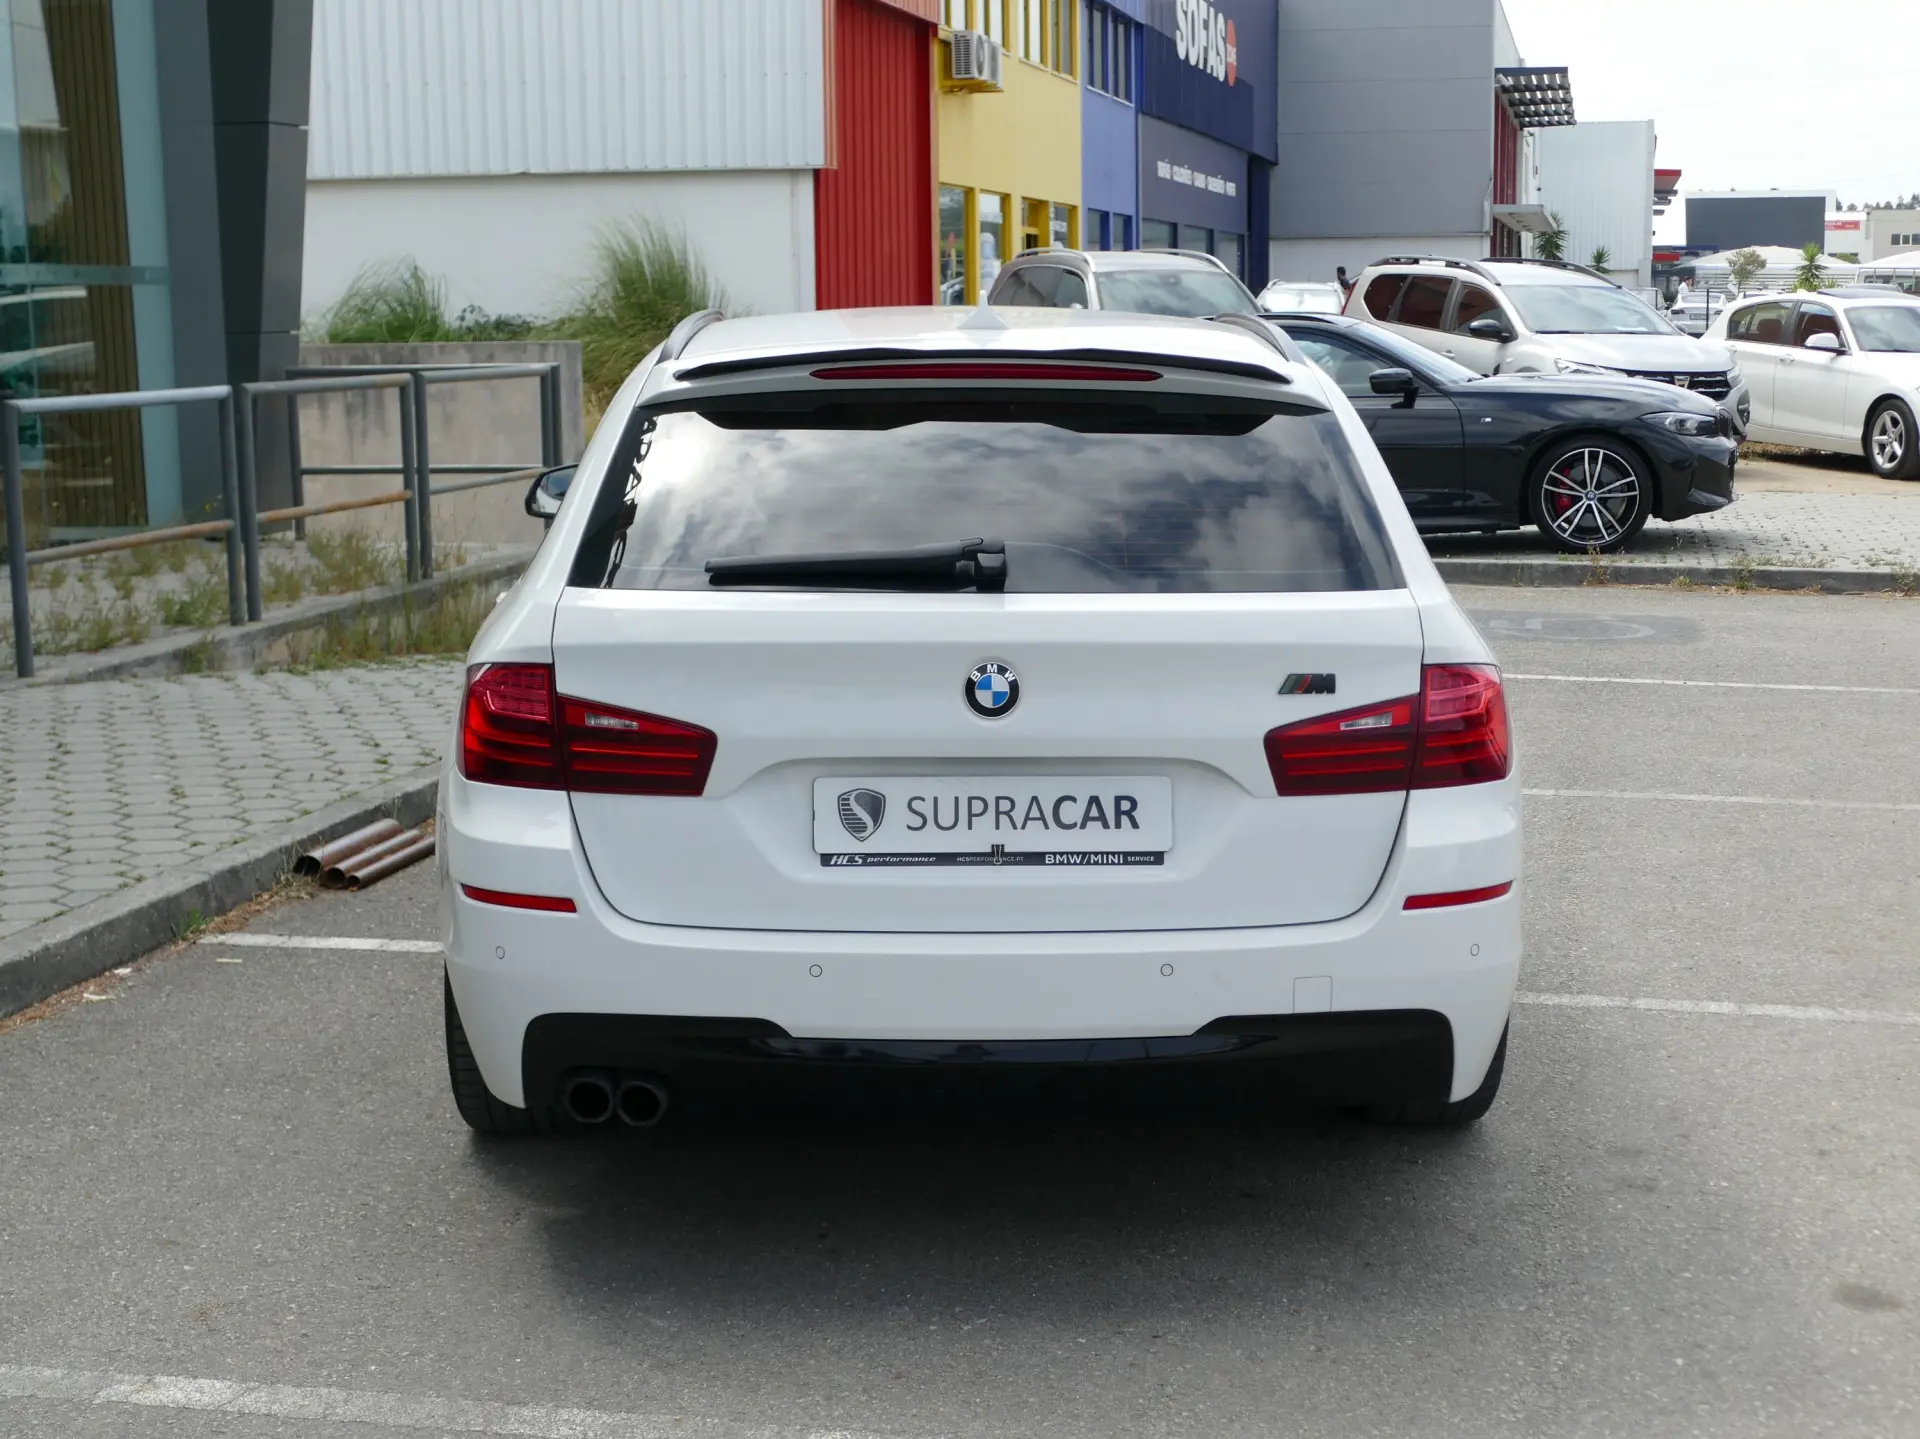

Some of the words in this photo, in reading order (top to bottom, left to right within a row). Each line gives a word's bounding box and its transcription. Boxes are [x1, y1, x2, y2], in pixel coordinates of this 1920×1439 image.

[970, 663, 1016, 682] BMW
[906, 795, 1140, 831] SUPRACAR
[830, 854, 865, 865] HCS
[1045, 853, 1123, 864] BMW/MINI
